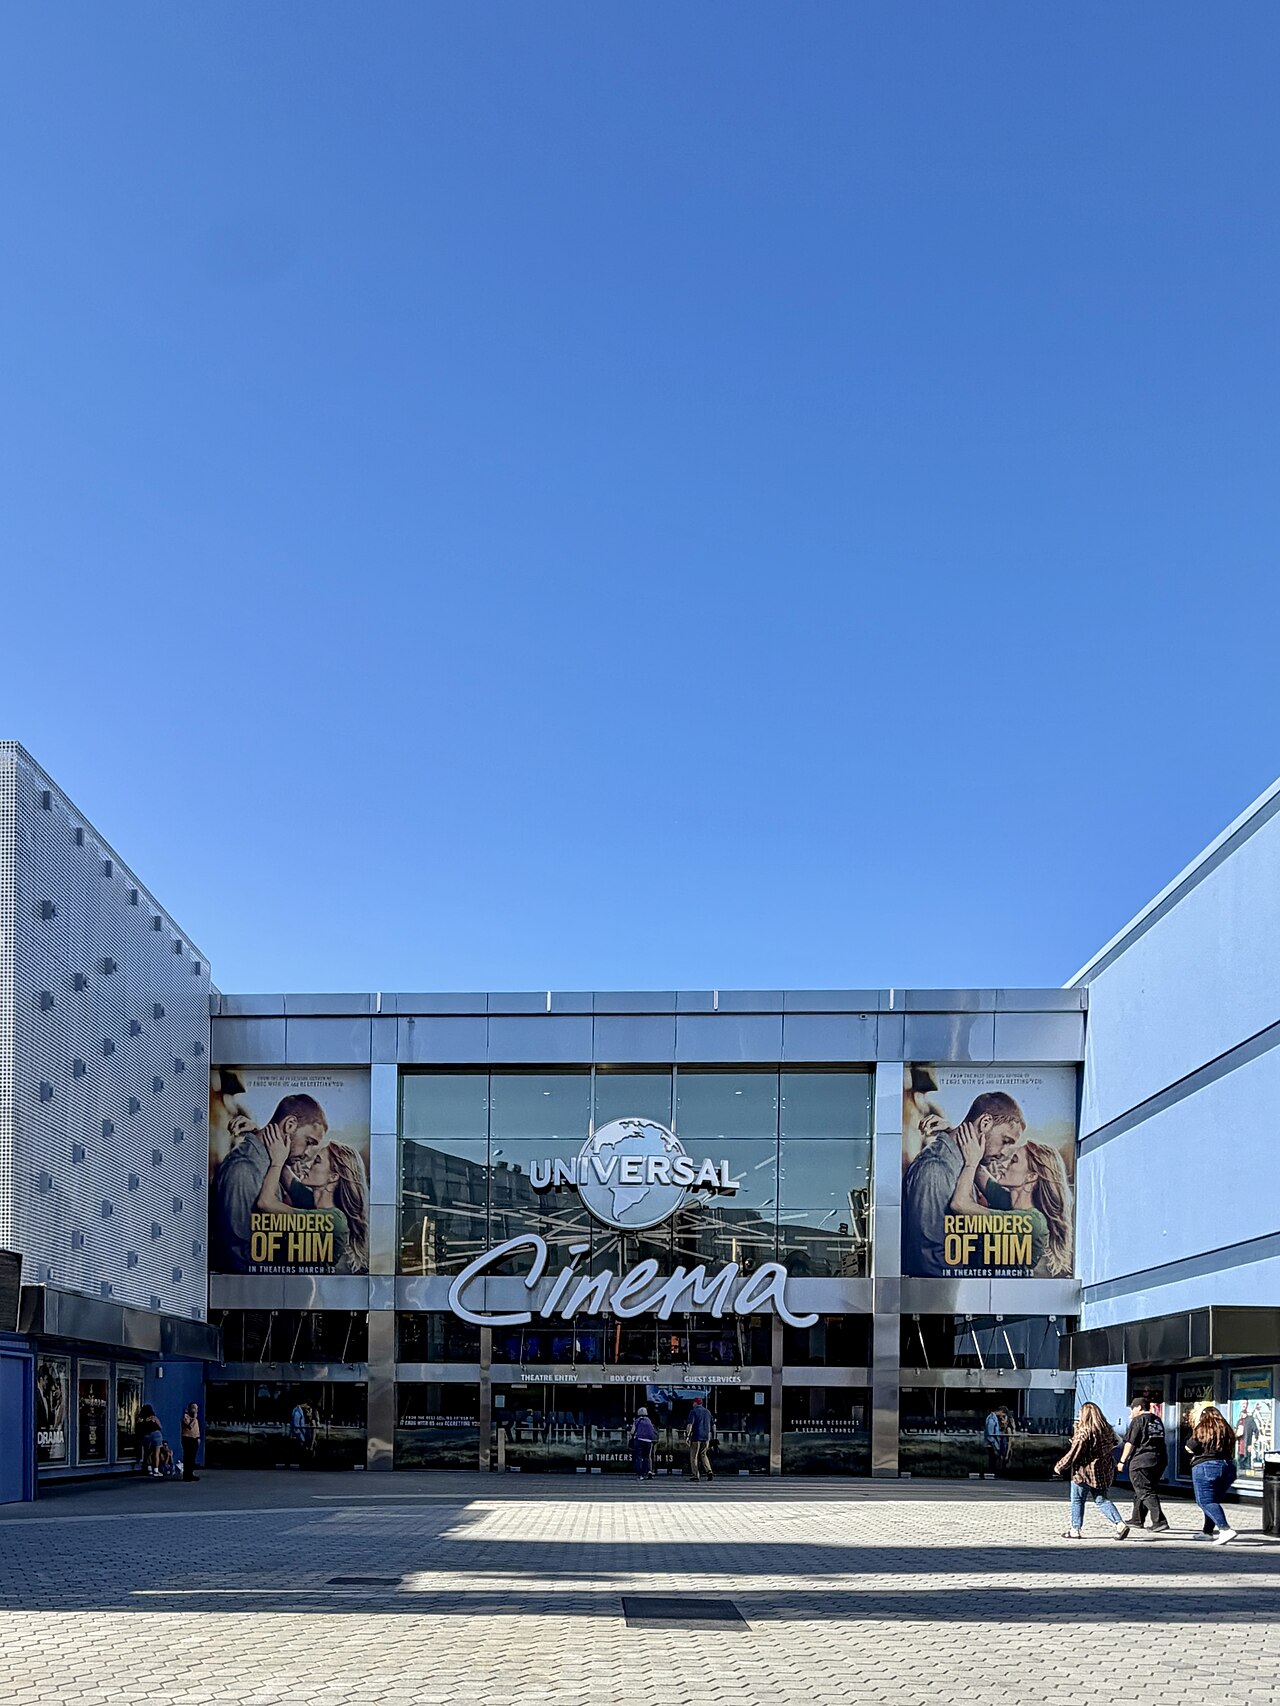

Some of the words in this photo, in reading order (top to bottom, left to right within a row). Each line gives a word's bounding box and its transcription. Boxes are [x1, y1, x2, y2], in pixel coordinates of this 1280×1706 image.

[529, 1154, 740, 1189] UNIVERSAL
[251, 1213, 334, 1232] REMINDERS
[944, 1215, 1033, 1233] REMINDERS
[251, 1232, 283, 1262] OF
[288, 1232, 333, 1262] HIM
[944, 1234, 978, 1265] OF
[984, 1234, 1032, 1265] HIM
[248, 1265, 256, 1273] IN
[260, 1265, 296, 1274] THEATERS
[298, 1266, 324, 1274] MARCH
[328, 1266, 335, 1274] 13
[942, 1268, 951, 1276] IN
[954, 1268, 992, 1276] THEATERS
[995, 1268, 1022, 1276] MARCH
[1026, 1268, 1034, 1276] 13
[449, 1234, 819, 1328] Cinema
[520, 1374, 552, 1382] THEATRE
[554, 1374, 578, 1382] ENTRY
[37, 1431, 64, 1445] DRAMA
[584, 1453, 593, 1462] IN
[596, 1453, 633, 1462] THEATERS
[665, 1454, 674, 1462] 13
